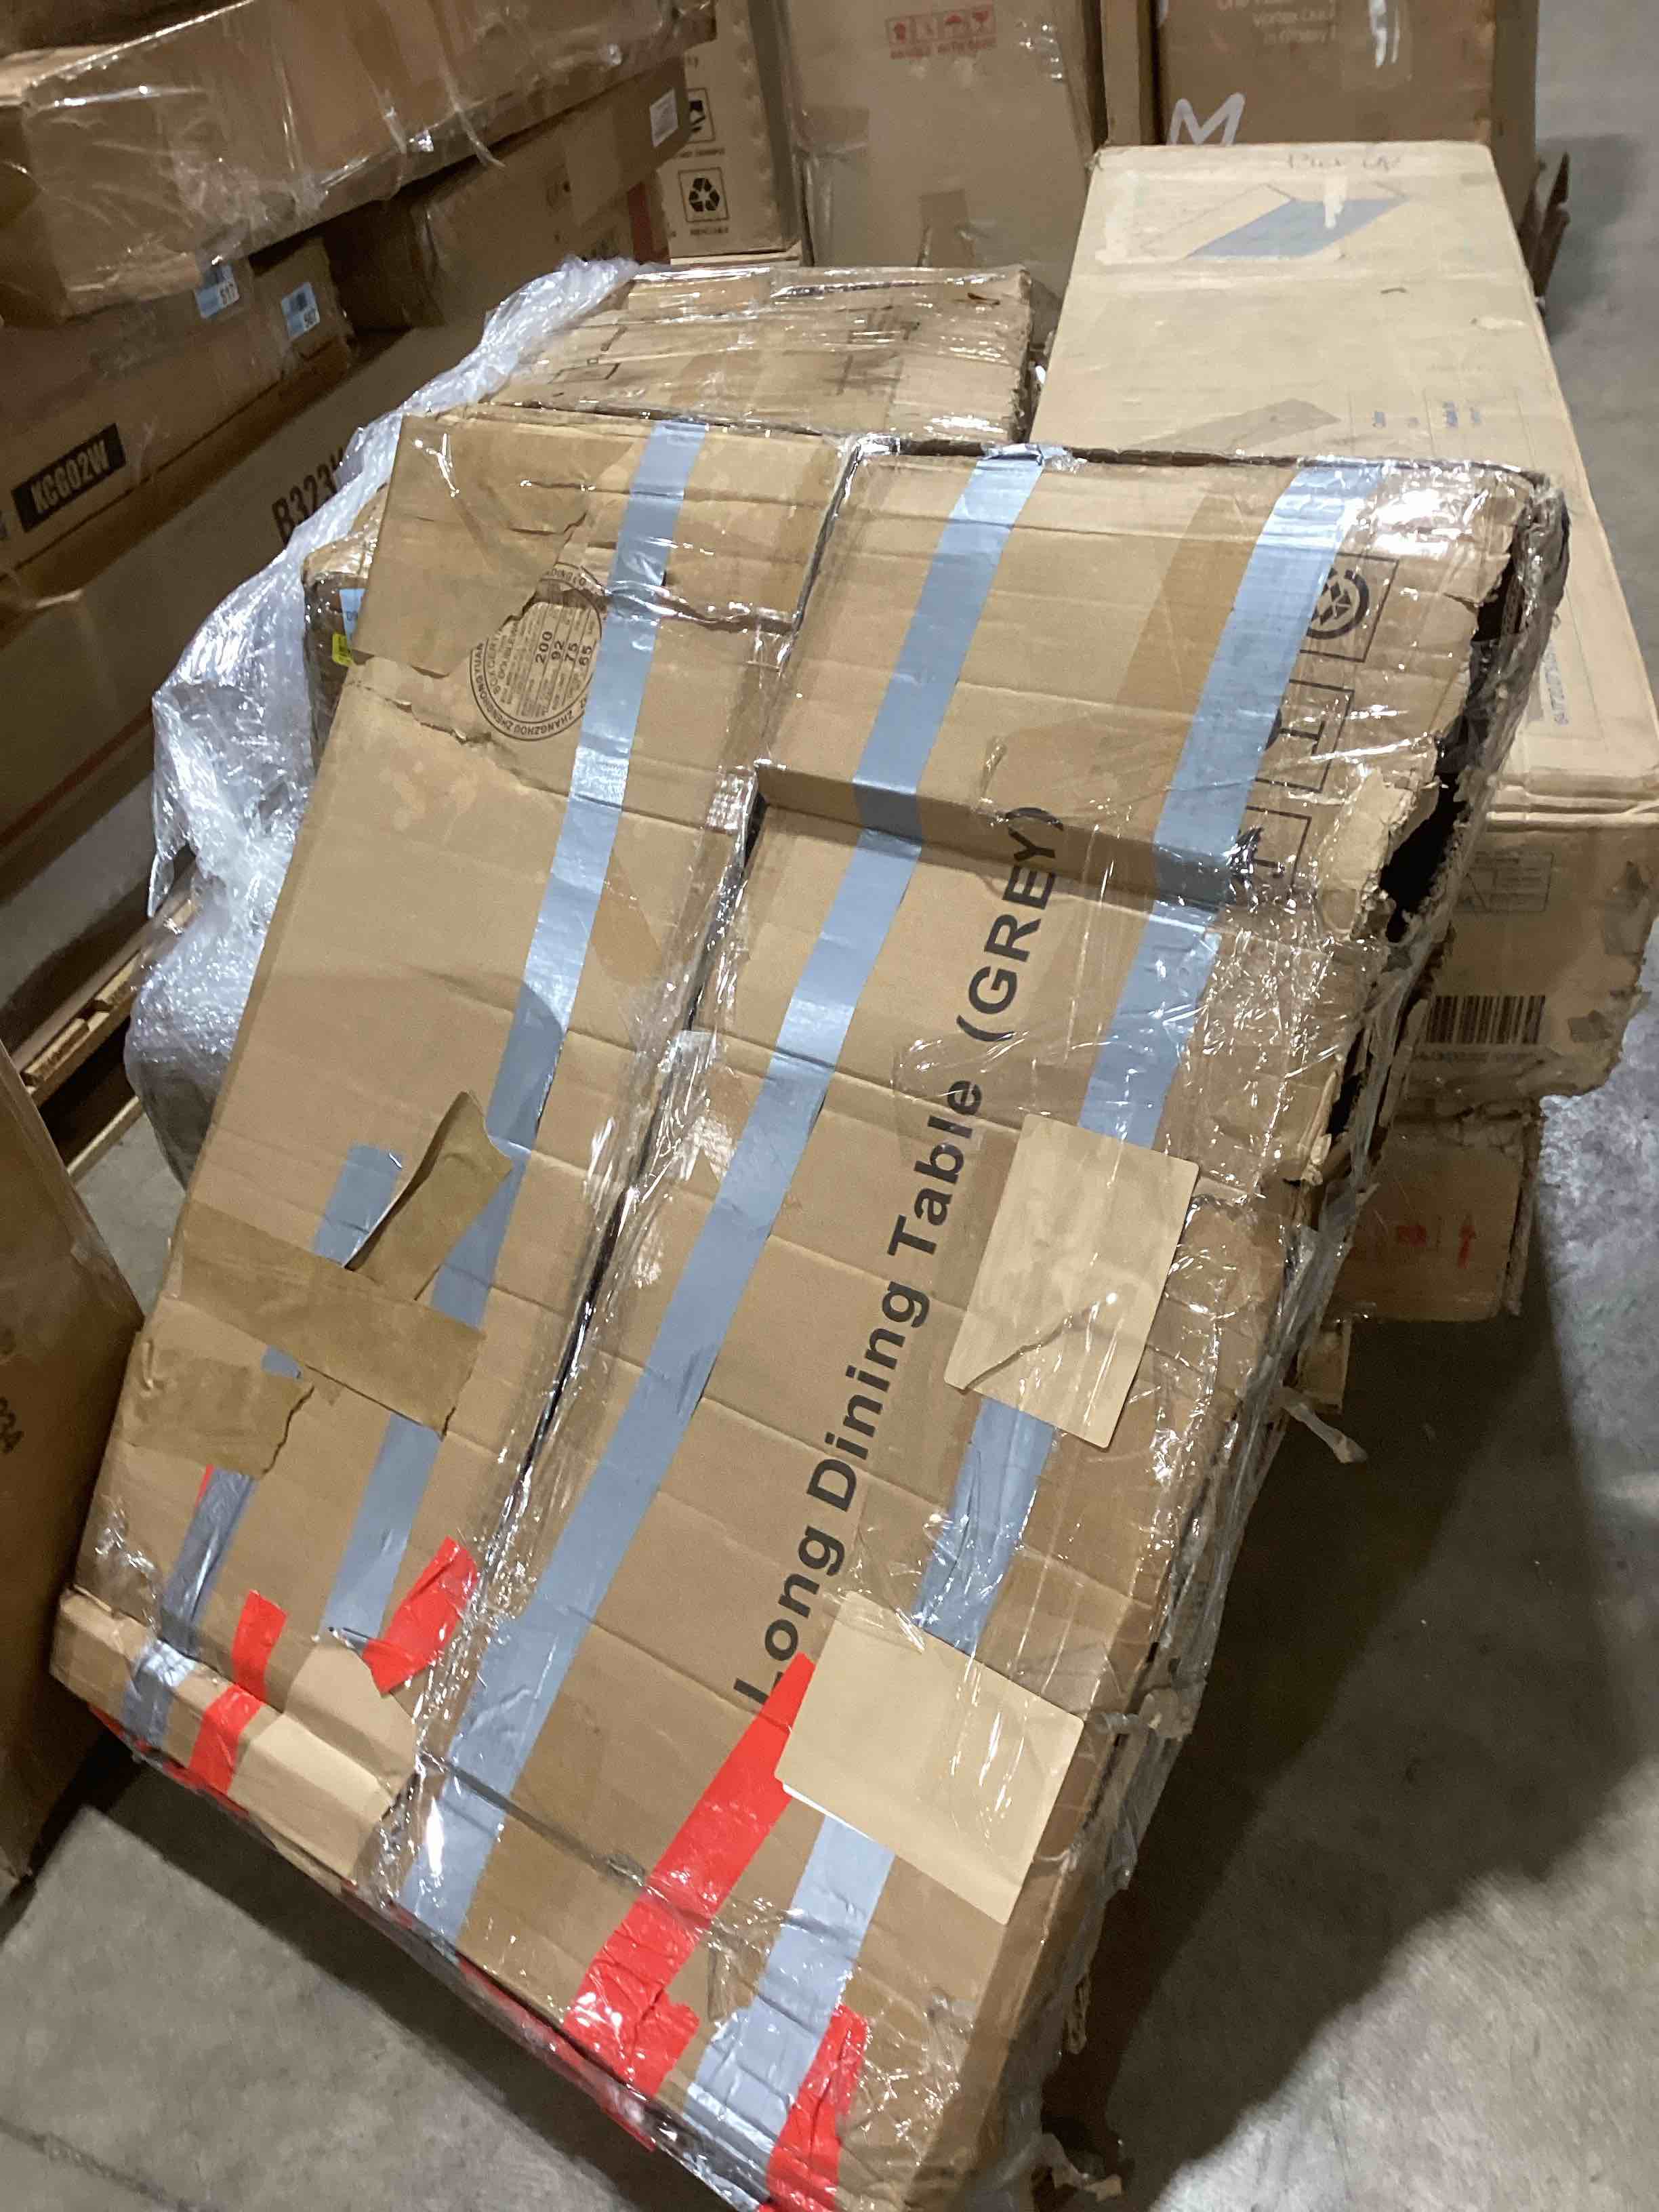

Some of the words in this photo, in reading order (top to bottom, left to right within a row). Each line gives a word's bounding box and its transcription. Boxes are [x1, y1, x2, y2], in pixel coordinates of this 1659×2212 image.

[535, 631, 552, 663] 200
[551, 640, 564, 660] 92
[564, 643, 578, 661] 75
[734, 1526, 846, 1704] Long
[806, 1281, 930, 1512] Dining
[888, 1078, 982, 1257] Table
[956, 806, 1065, 1042] (GREY)
